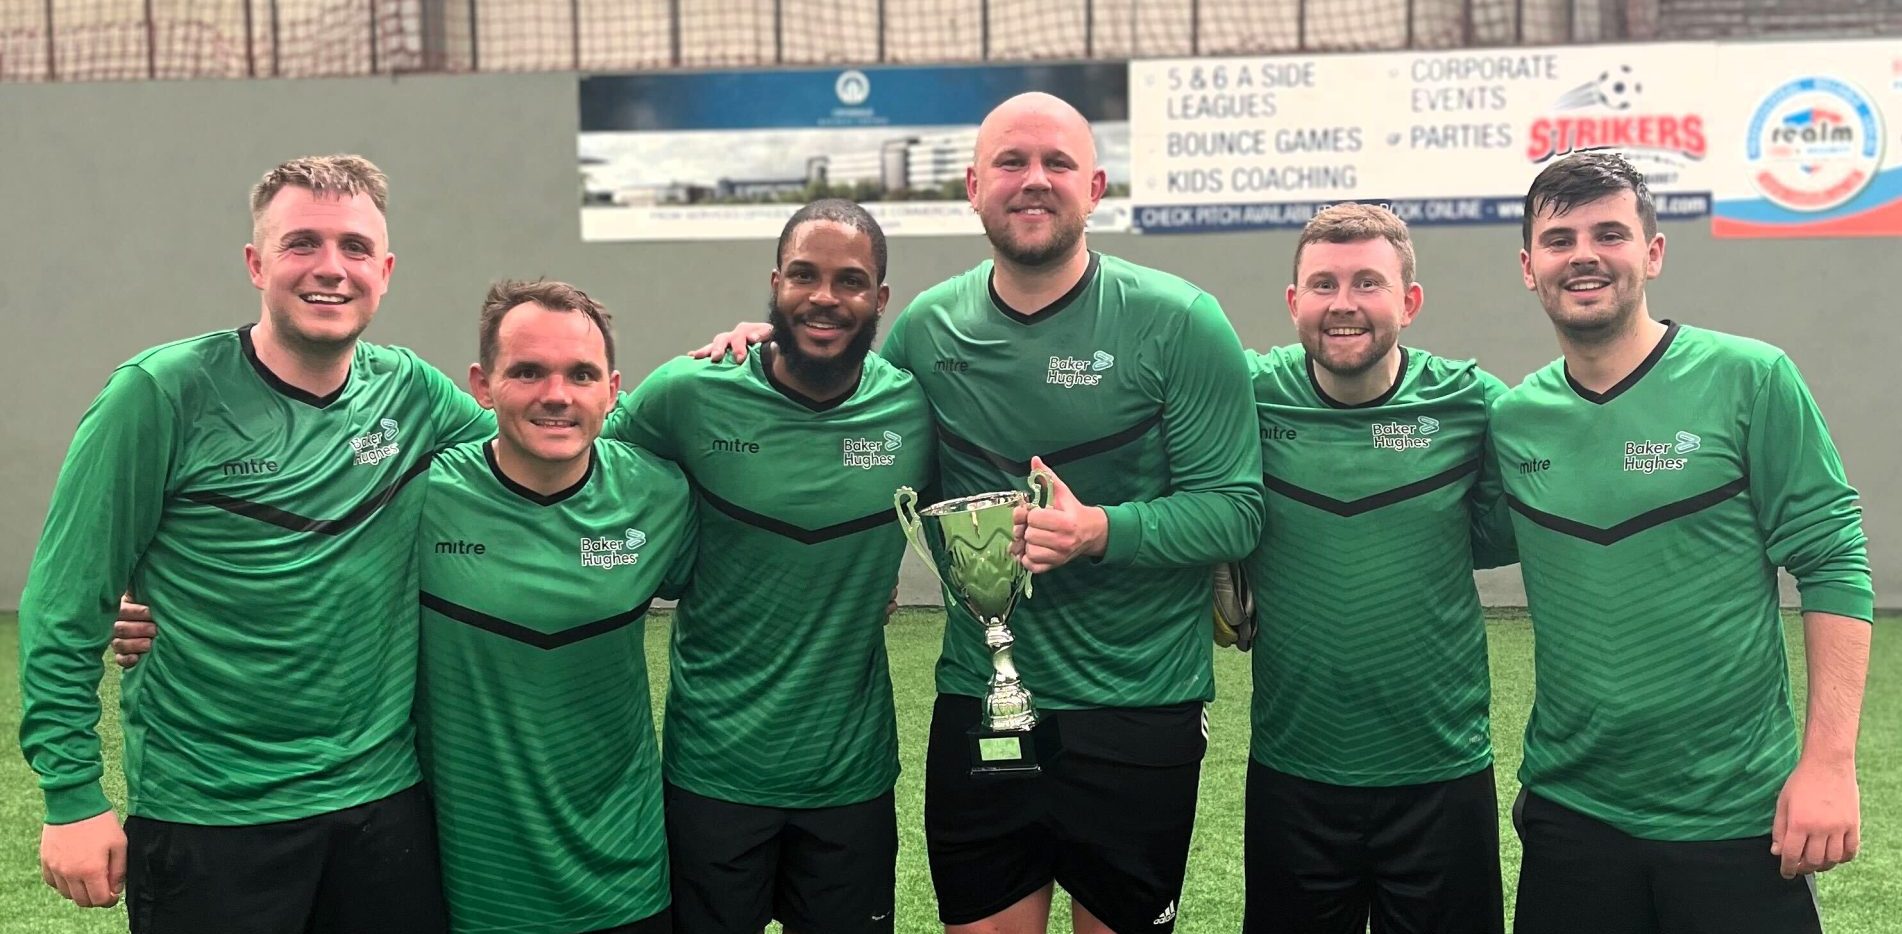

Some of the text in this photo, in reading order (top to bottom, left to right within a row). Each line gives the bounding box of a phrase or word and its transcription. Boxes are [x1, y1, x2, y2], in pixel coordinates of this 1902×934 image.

[1168, 61, 1316, 91] 5 & 6 A SIDE
[1411, 55, 1558, 83] CORPORATE
[1167, 92, 1277, 121] LEAGUES
[1411, 85, 1507, 113] EVENTS
[1410, 123, 1512, 149] PARTIES
[1527, 114, 1706, 161] STRIKERS
[1771, 121, 1853, 143] realm
[1167, 126, 1363, 158] BOUNCE GAMES
[1167, 164, 1357, 194] KIDS COACHING
[1141, 206, 1191, 228] CHECK
[1197, 205, 1241, 225] PITCH
[1425, 199, 1482, 220] ONLINE
[935, 357, 969, 373] mitre
[1049, 355, 1090, 371] Baker
[1047, 370, 1100, 388] Hughes
[1372, 422, 1416, 436] Baker
[712, 438, 760, 454] mitre
[844, 437, 882, 452] Baker
[1373, 435, 1431, 451] Hughes
[1625, 440, 1671, 455] Baker
[223, 459, 278, 476] mitre
[844, 452, 894, 469] Hughes
[1519, 459, 1551, 475] mitre
[1624, 455, 1687, 474] Hughes
[435, 540, 486, 555] mitre
[581, 537, 623, 552] Baker
[581, 551, 638, 569] Hughes
